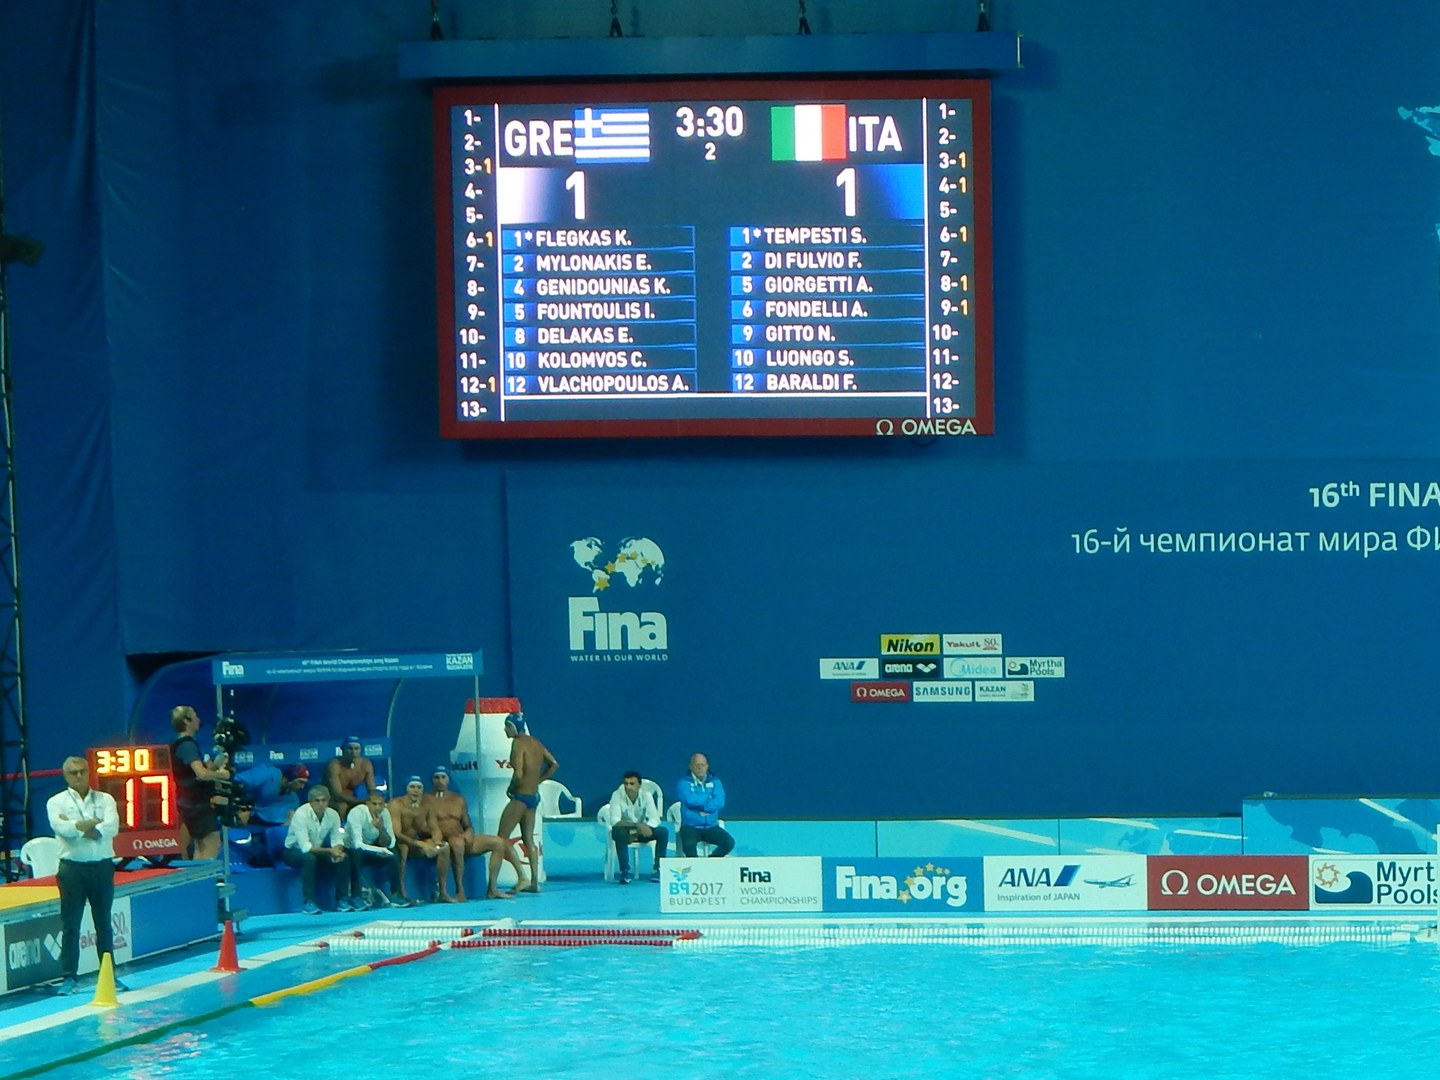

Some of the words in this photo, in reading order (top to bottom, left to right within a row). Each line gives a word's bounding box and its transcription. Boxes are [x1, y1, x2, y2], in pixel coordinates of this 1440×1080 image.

[675, 106, 744, 138] 3:30
[504, 119, 574, 157] GRE
[848, 115, 902, 152] ITA
[704, 142, 717, 161] 2
[565, 170, 586, 220] 1
[836, 167, 857, 217] 1
[536, 231, 612, 247] FLEGKAS
[615, 229, 632, 246] K.
[764, 228, 847, 244] TEMPESTI
[851, 227, 867, 243] S.
[514, 255, 524, 272] 2
[537, 254, 632, 271] MYLONAKIS
[636, 254, 652, 270] E.
[742, 252, 752, 269] 2
[765, 252, 782, 269] DI
[786, 252, 844, 269] FULVIO
[848, 251, 862, 268] F.
[514, 279, 525, 295] 4
[537, 278, 650, 295] GENIDOUNIAS
[654, 277, 671, 294] K.
[742, 276, 752, 293] 5
[765, 276, 852, 292] GIORGETTI
[856, 275, 873, 292] A.
[515, 303, 525, 320] 5
[537, 303, 641, 320] FOUNTOULIS
[645, 302, 655, 319] I.
[742, 300, 752, 317] 6
[766, 301, 847, 317] FONDELLI
[851, 300, 868, 317] A.
[515, 328, 525, 344] 8
[538, 327, 614, 344] DELAKAS
[618, 326, 633, 343] E.
[743, 325, 753, 342] 9
[766, 325, 814, 342] GITTO
[818, 325, 835, 341] N.
[507, 352, 526, 368] 10
[538, 352, 627, 368] KOLOMVOS
[631, 351, 647, 367] C.
[735, 350, 754, 366] 10
[767, 350, 834, 366] LUONGO
[838, 350, 854, 366] S.
[507, 376, 526, 393] 12
[538, 375, 668, 392] VLACHOPOULOS
[672, 374, 689, 391] A.
[735, 374, 754, 390] 12
[767, 373, 839, 390] BARALDI
[843, 373, 857, 390] F.
[901, 419, 977, 436] OMEGA
[1309, 481, 1360, 508] 16th
[1071, 526, 1131, 554] 16-й
[1139, 530, 1310, 553] чемпионат
[1318, 530, 1398, 559] мира
[568, 596, 668, 651] Fina
[887, 638, 934, 653] Nikon
[947, 640, 981, 648] Yakult
[614, 654, 633, 662] OUR
[635, 653, 669, 661] WORLD
[832, 660, 857, 671] ANA
[1029, 659, 1063, 670] Myrtha
[885, 663, 913, 673] arena
[1030, 667, 1055, 676] Pools
[870, 688, 906, 698] OMEGA
[915, 686, 971, 696] SAMSUNG
[96, 749, 150, 774] 3:30
[126, 775, 169, 827] 17
[144, 839, 178, 849] OMEGA
[740, 867, 771, 883] Fina
[998, 868, 1051, 888] ANA
[691, 883, 724, 896] 2017
[740, 887, 776, 895] WORLD
[1197, 874, 1296, 896] OMEGA
[669, 897, 727, 906] BUDAPEST
[740, 896, 818, 905] CHAMPIONSHIPS
[997, 893, 1041, 902] Inspiration
[1042, 893, 1052, 901] of
[1053, 893, 1080, 901] JAPAN
[9, 938, 41, 970] arena
